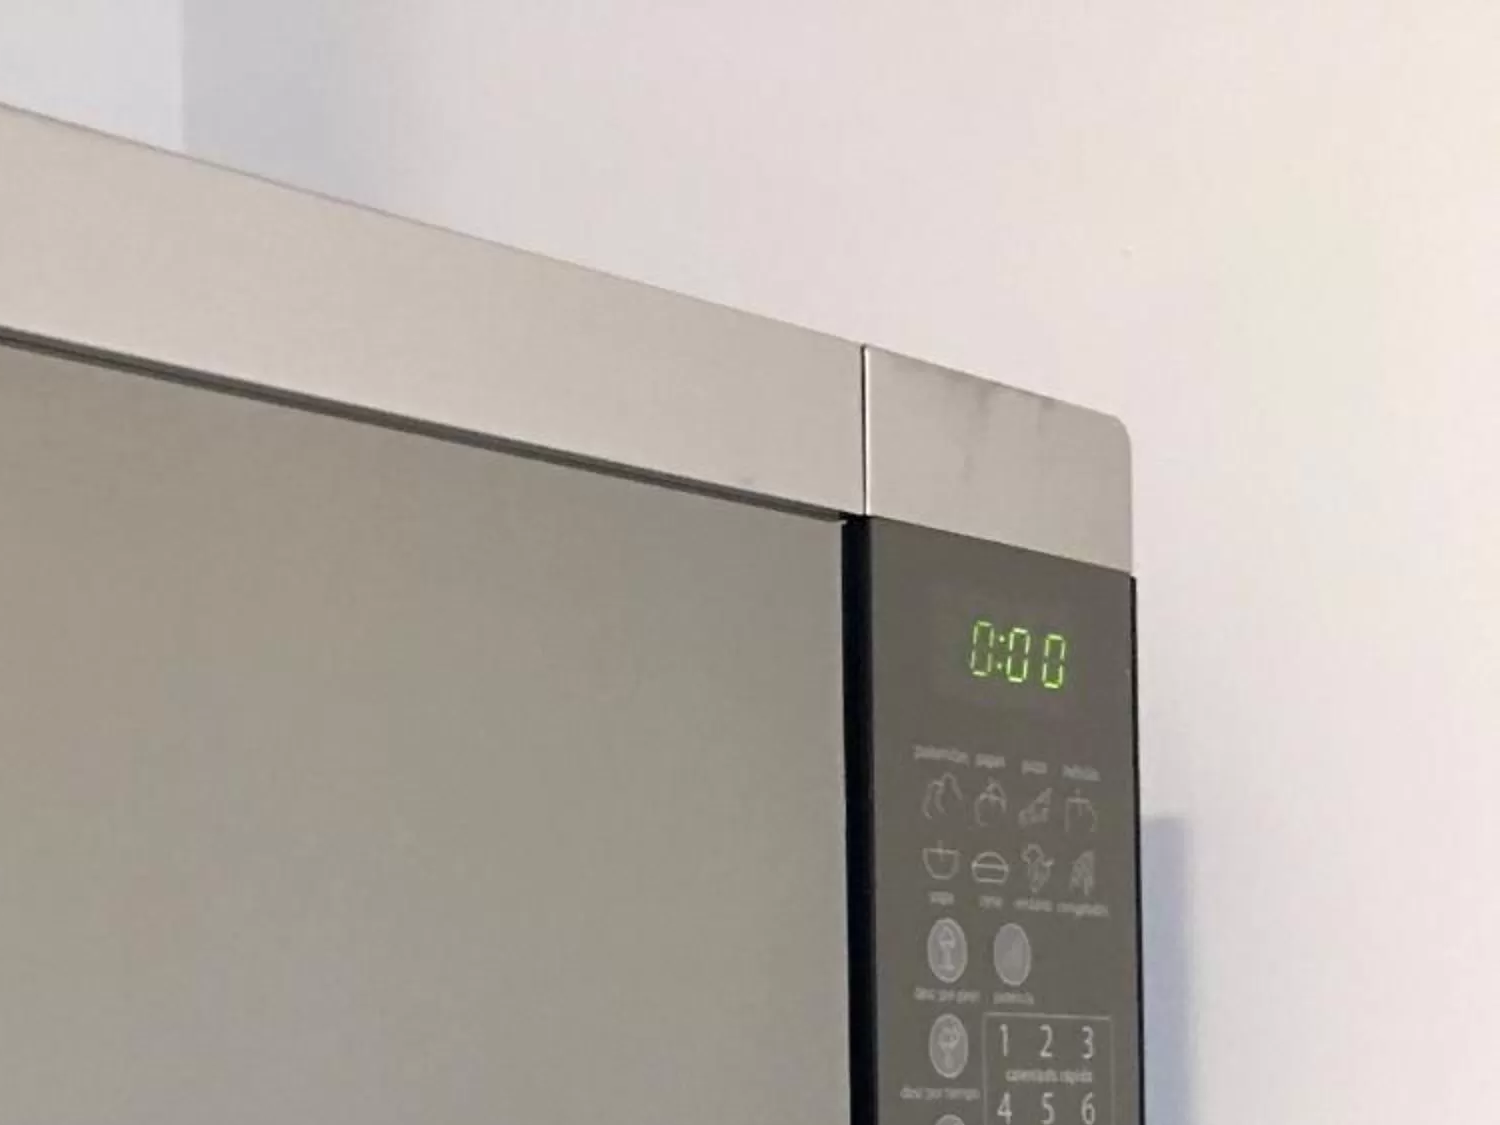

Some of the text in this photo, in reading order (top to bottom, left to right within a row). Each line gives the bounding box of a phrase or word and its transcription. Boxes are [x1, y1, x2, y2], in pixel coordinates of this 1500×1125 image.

[970, 620, 1066, 689] 0:00
[999, 1023, 1095, 1059] 1 2 3
[997, 1092, 1013, 1125] 4
[1040, 1092, 1056, 1125] 5
[1080, 1092, 1096, 1125] 6
